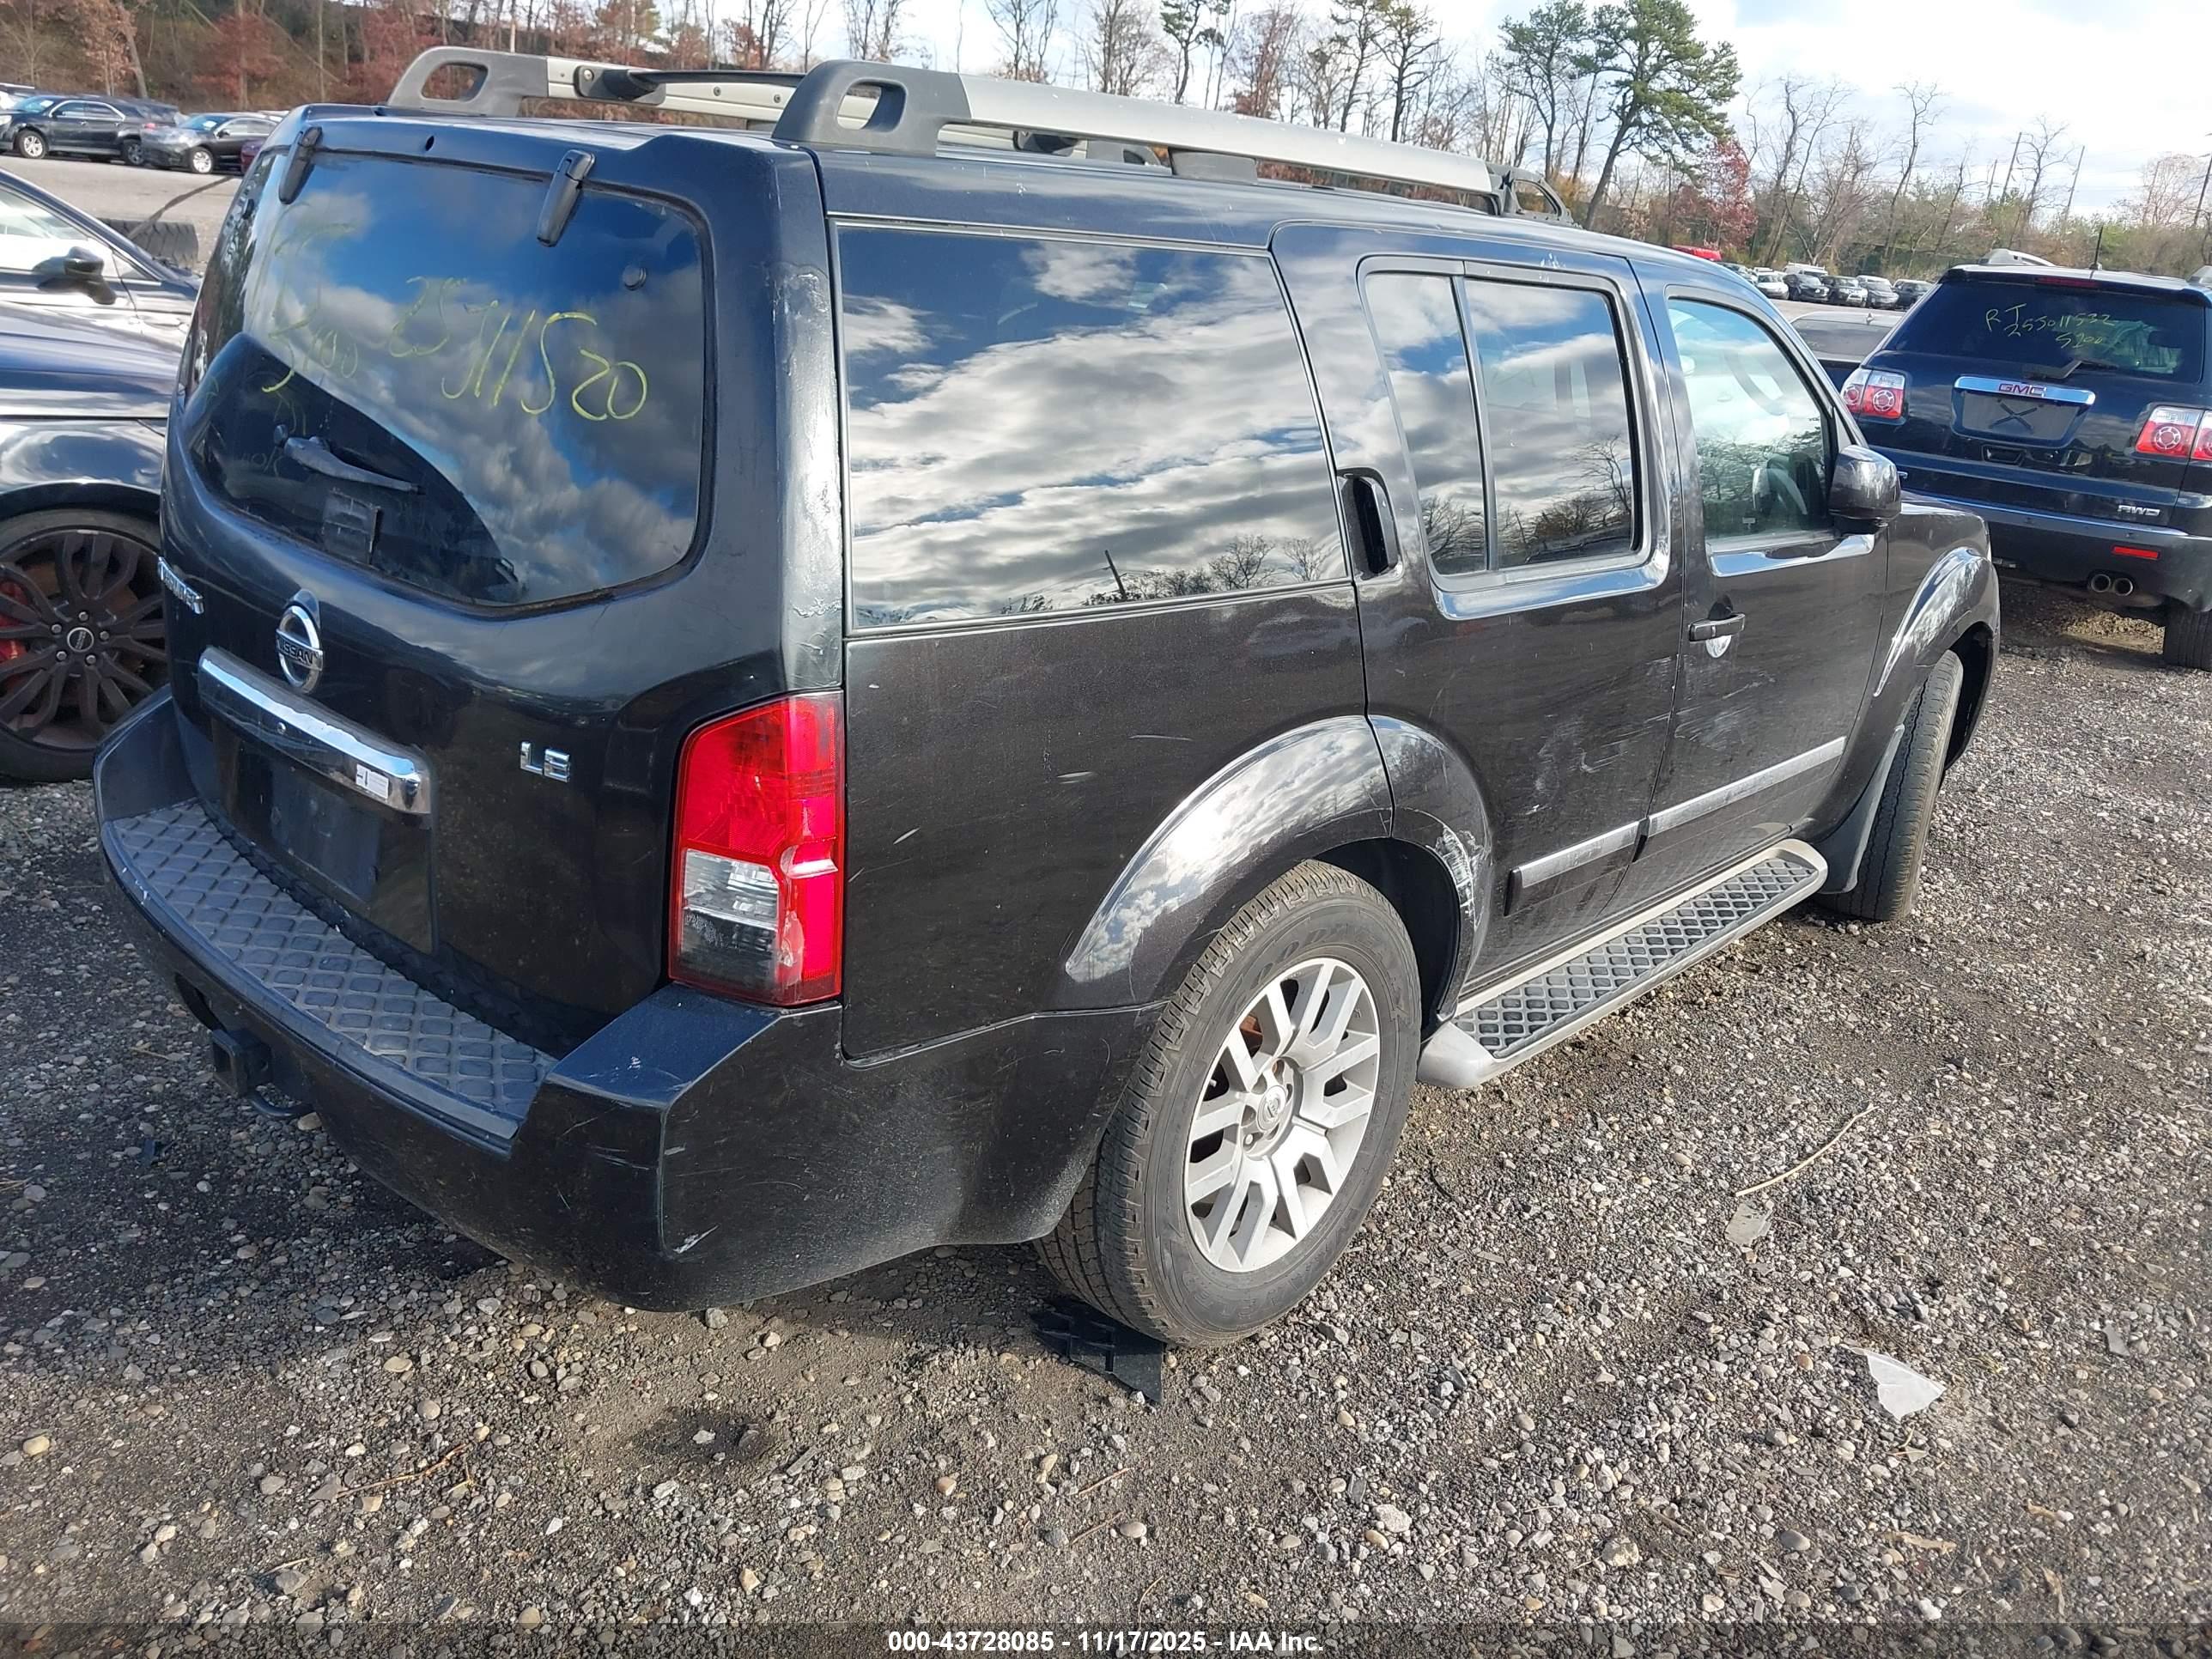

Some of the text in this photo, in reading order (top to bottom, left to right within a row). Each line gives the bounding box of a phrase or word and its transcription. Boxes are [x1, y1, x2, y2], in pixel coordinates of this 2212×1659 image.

[1999, 383, 2047, 398] GMC
[2117, 505, 2160, 516] AWD
[279, 634, 314, 664] NISSAN
[520, 741, 570, 783] LE
